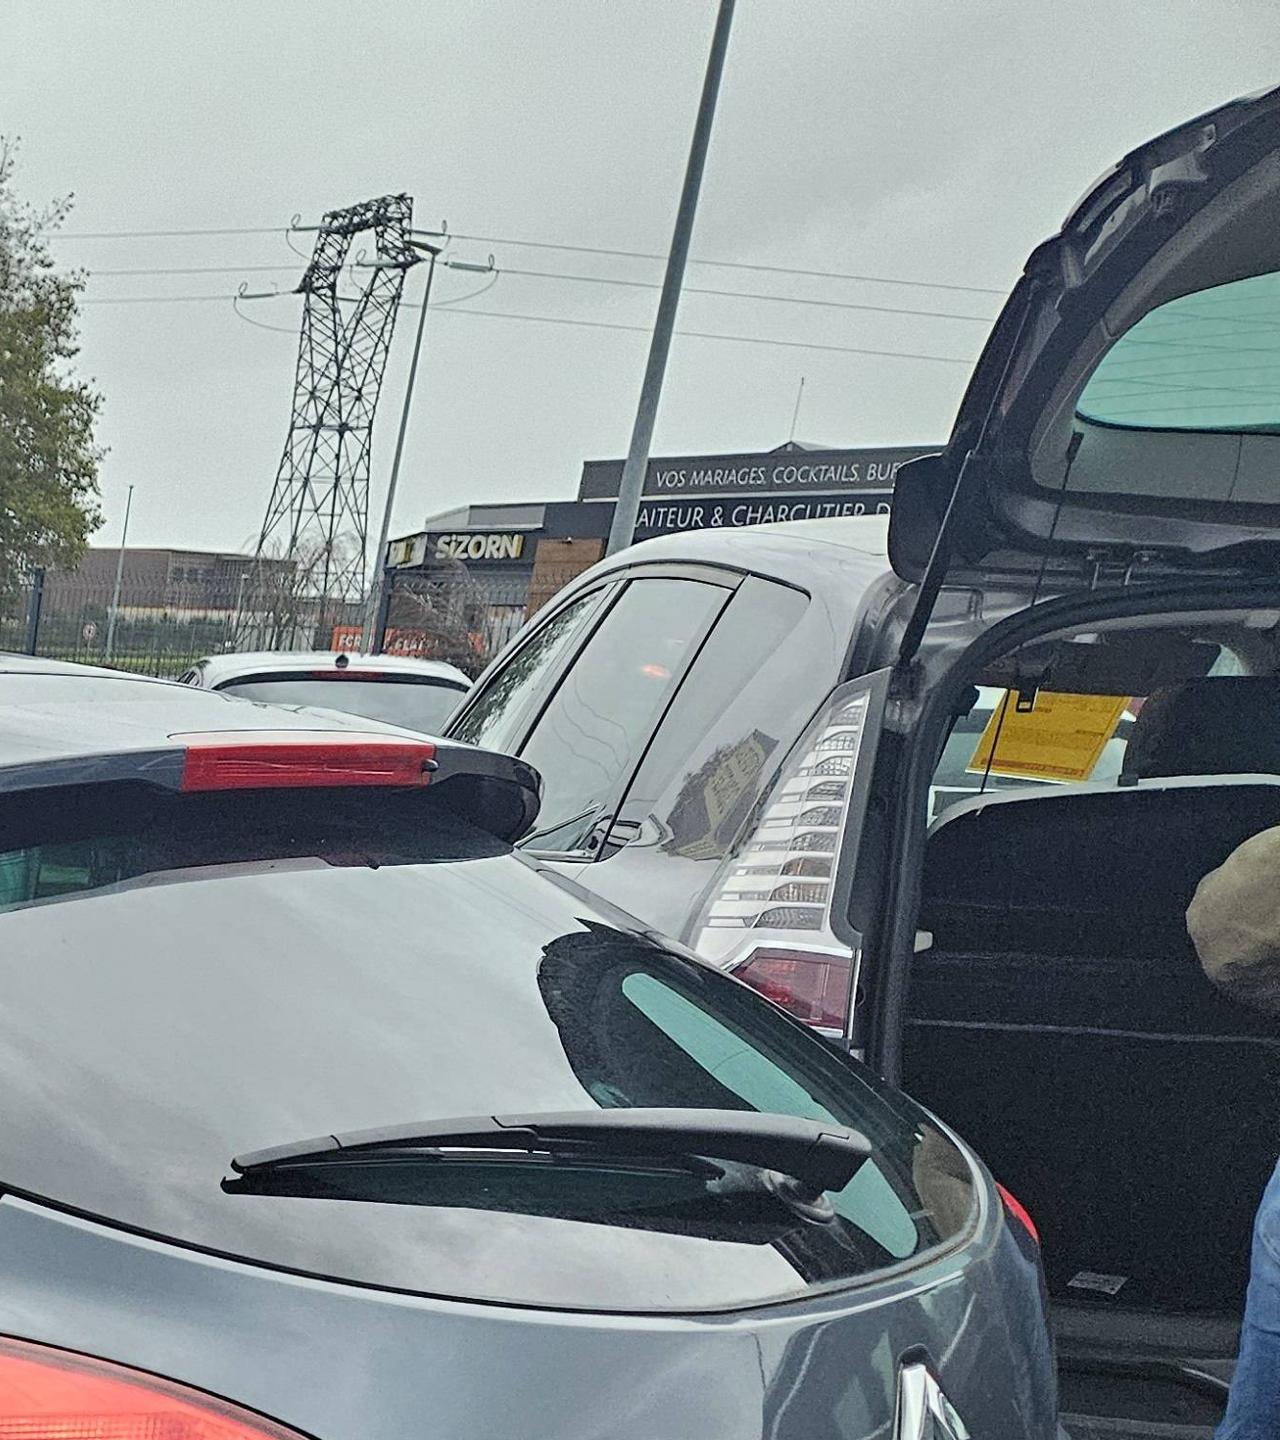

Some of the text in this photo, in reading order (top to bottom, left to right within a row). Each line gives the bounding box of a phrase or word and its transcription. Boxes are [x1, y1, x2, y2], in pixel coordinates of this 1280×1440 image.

[656, 470, 687, 487] VOS
[867, 462, 898, 480] BUF
[635, 506, 704, 527] AITEUR
[710, 506, 724, 526] &
